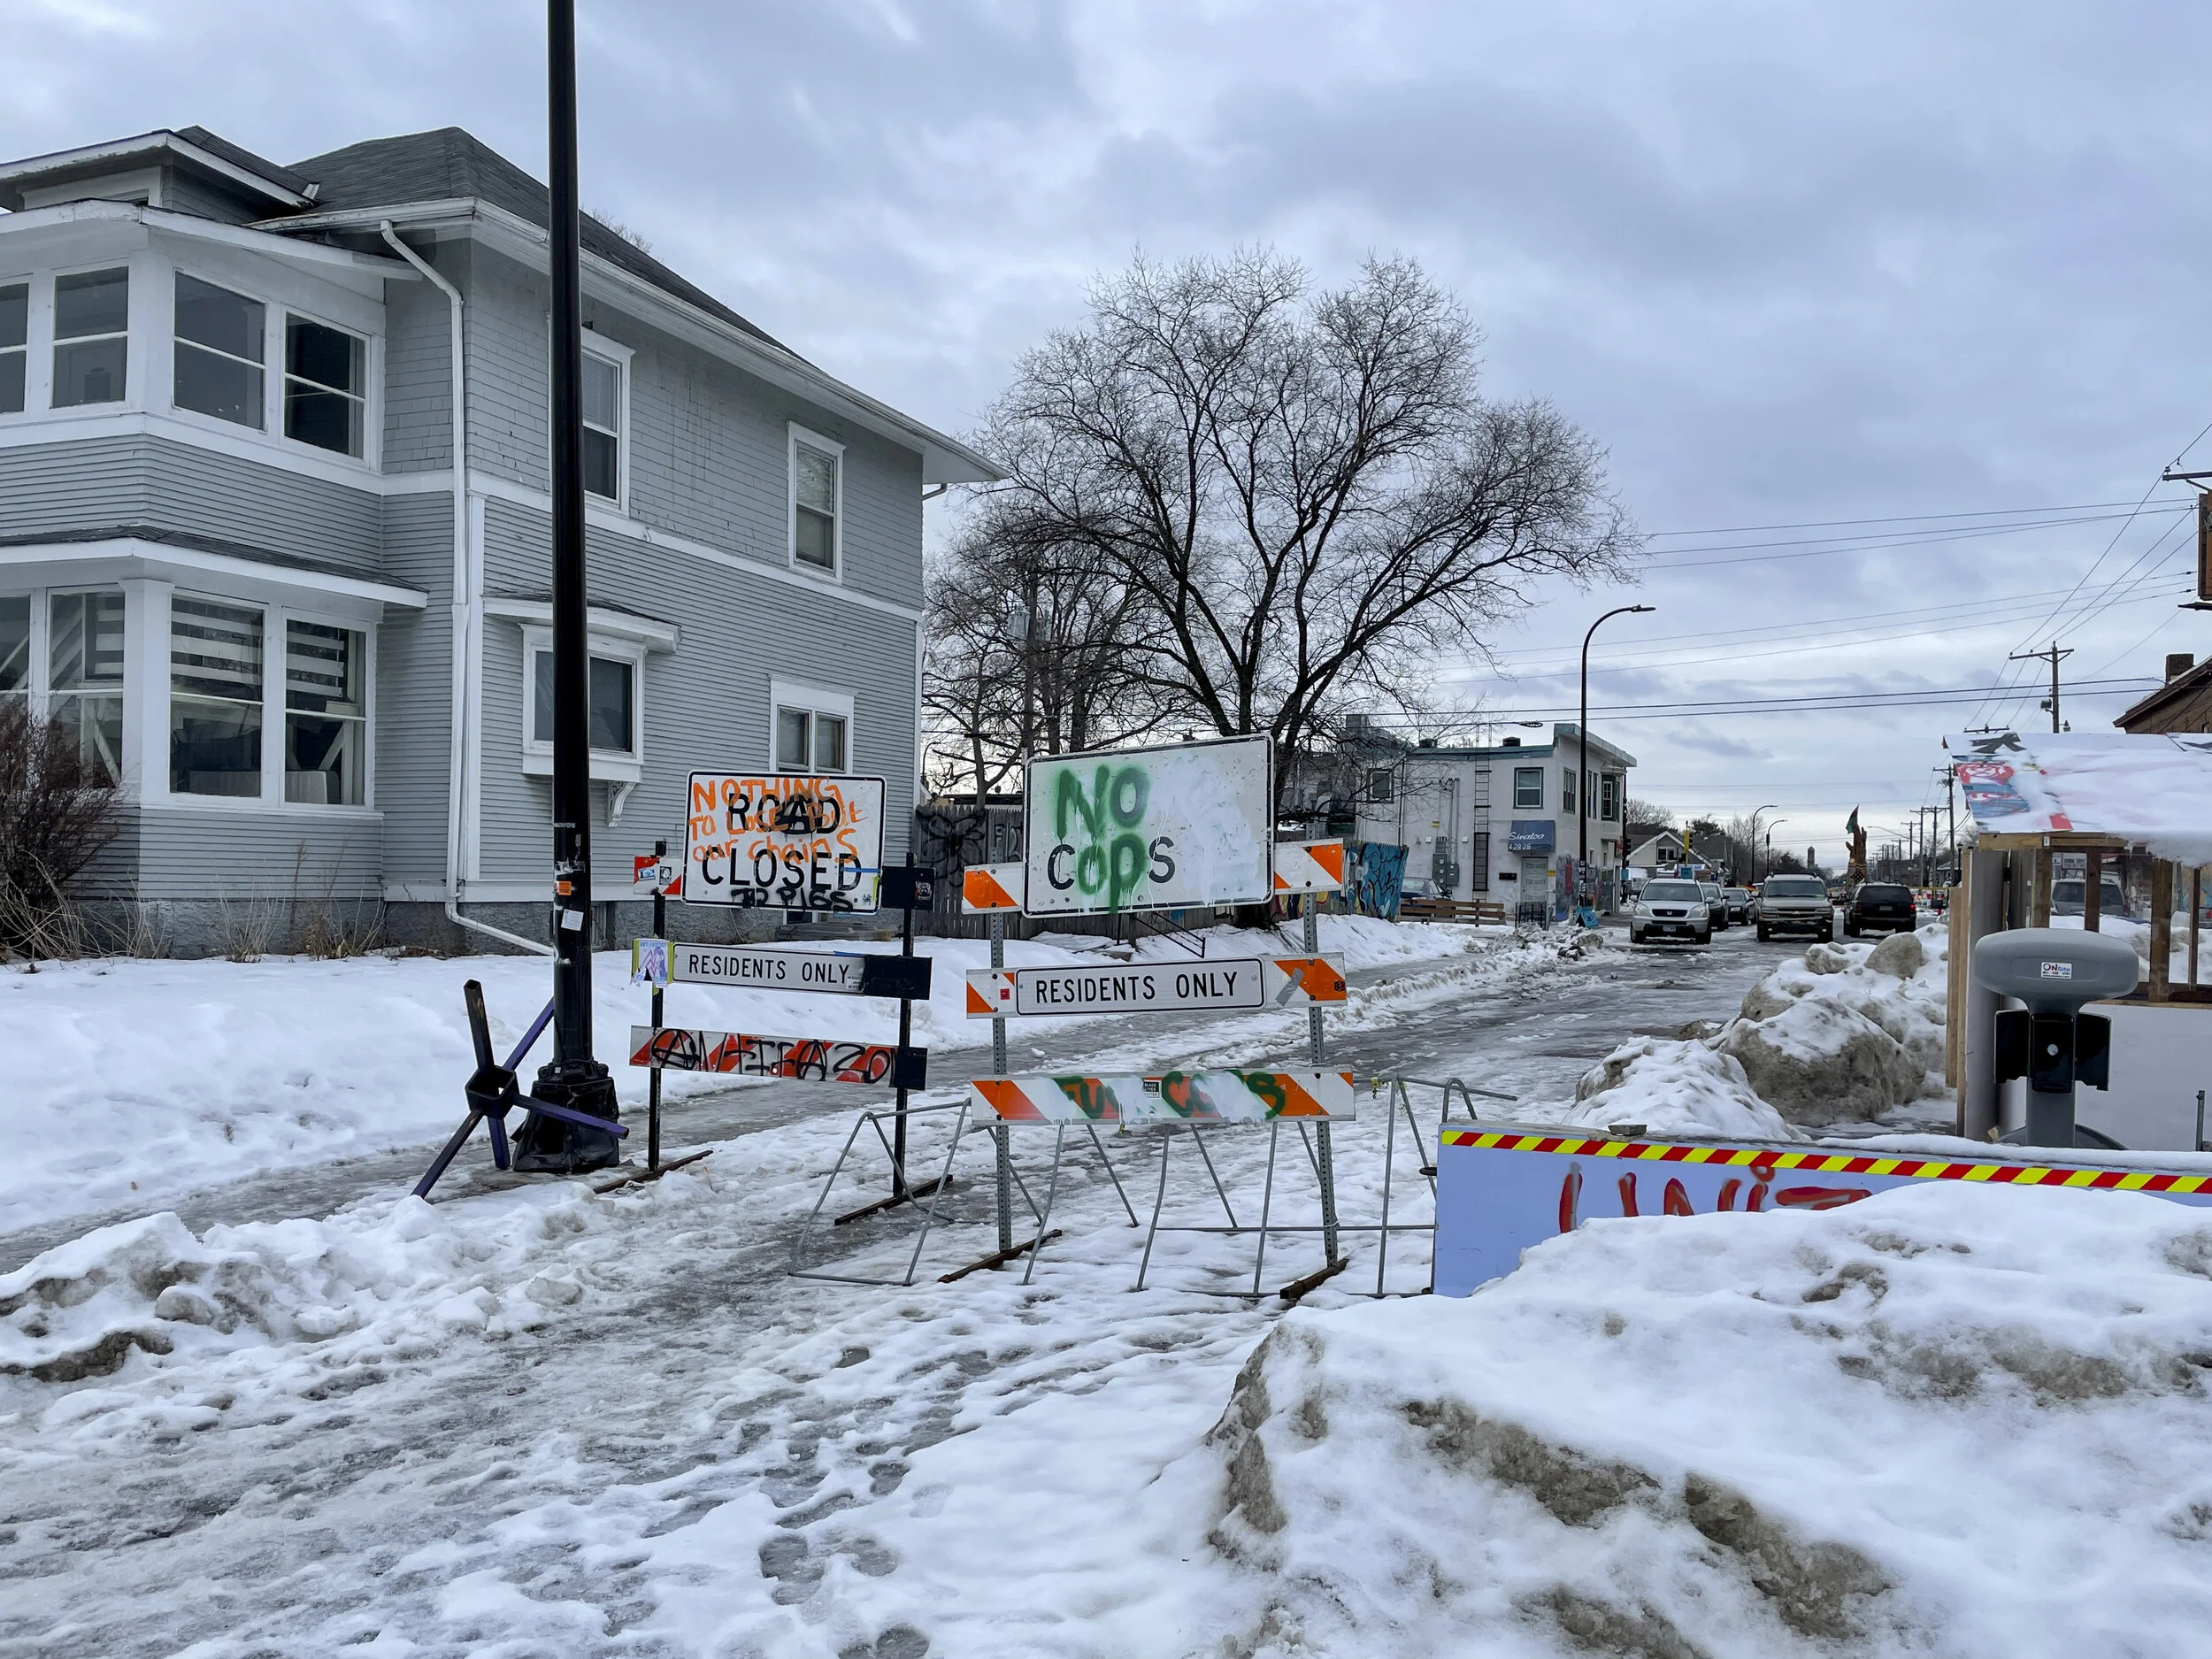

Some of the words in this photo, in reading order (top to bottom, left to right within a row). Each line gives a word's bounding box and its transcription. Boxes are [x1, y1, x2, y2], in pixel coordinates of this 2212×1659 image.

[693, 776, 845, 813] NOTHING
[1056, 764, 1150, 839] NO
[687, 814, 716, 841] TO
[728, 793, 841, 833] ROAD
[1509, 831, 1545, 841] Sinaloa
[702, 848, 861, 891] CLOSED
[688, 954, 787, 980] RESIDENTS
[802, 962, 849, 984] ONLY
[1036, 975, 1156, 1003] RESIDENTS
[1176, 972, 1238, 999] ONLY
